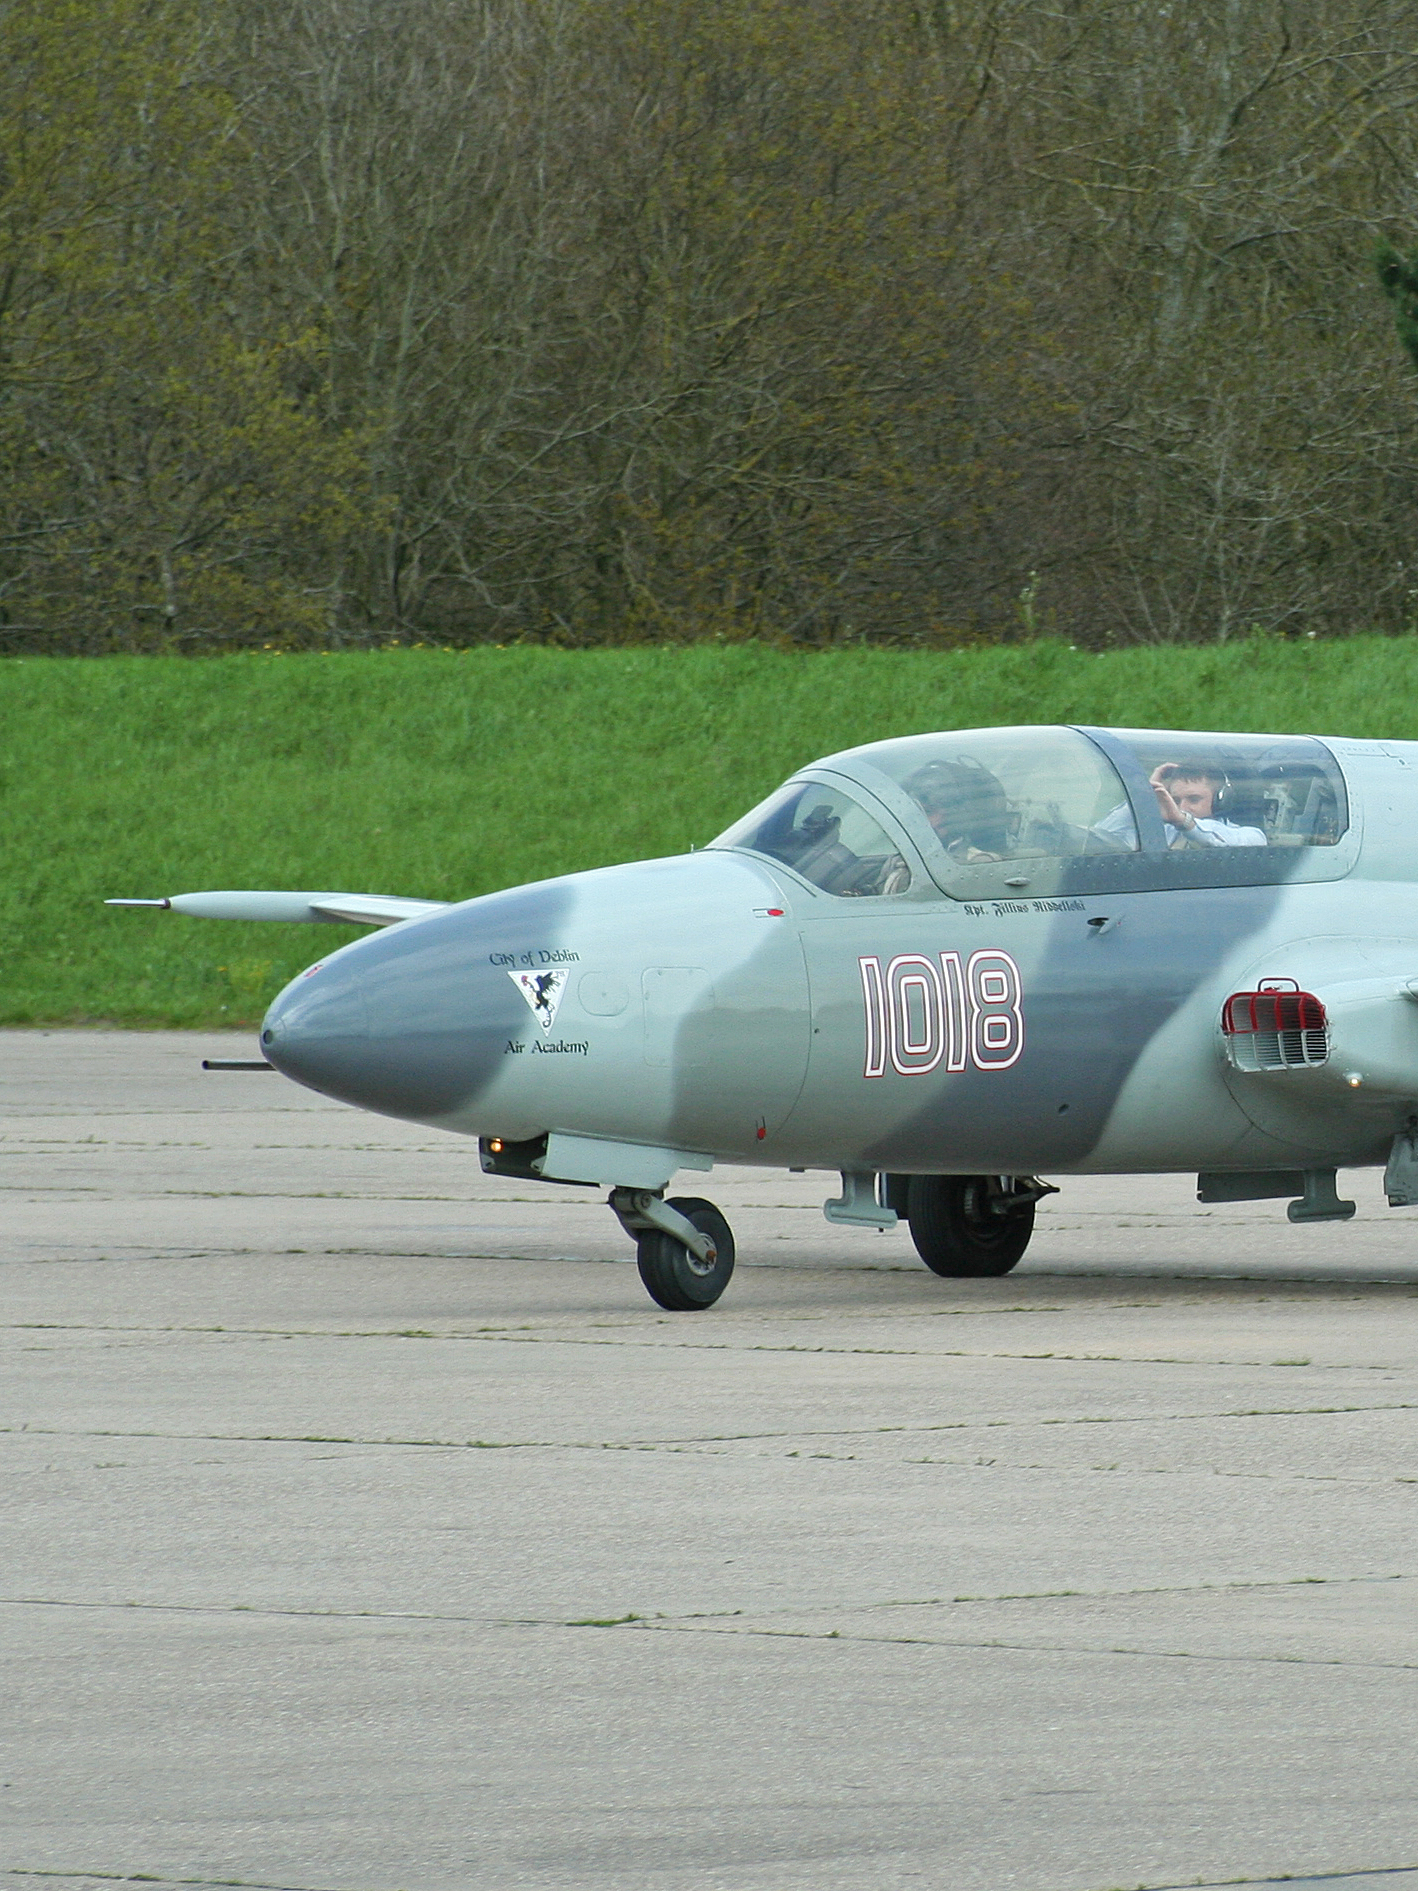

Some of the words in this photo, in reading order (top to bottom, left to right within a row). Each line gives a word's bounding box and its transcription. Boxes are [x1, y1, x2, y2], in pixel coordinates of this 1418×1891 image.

[489, 953, 515, 967] City
[520, 951, 535, 966] of
[858, 948, 1025, 1078] 1018
[504, 1041, 526, 1054] Air
[532, 1040, 589, 1056] Academy
